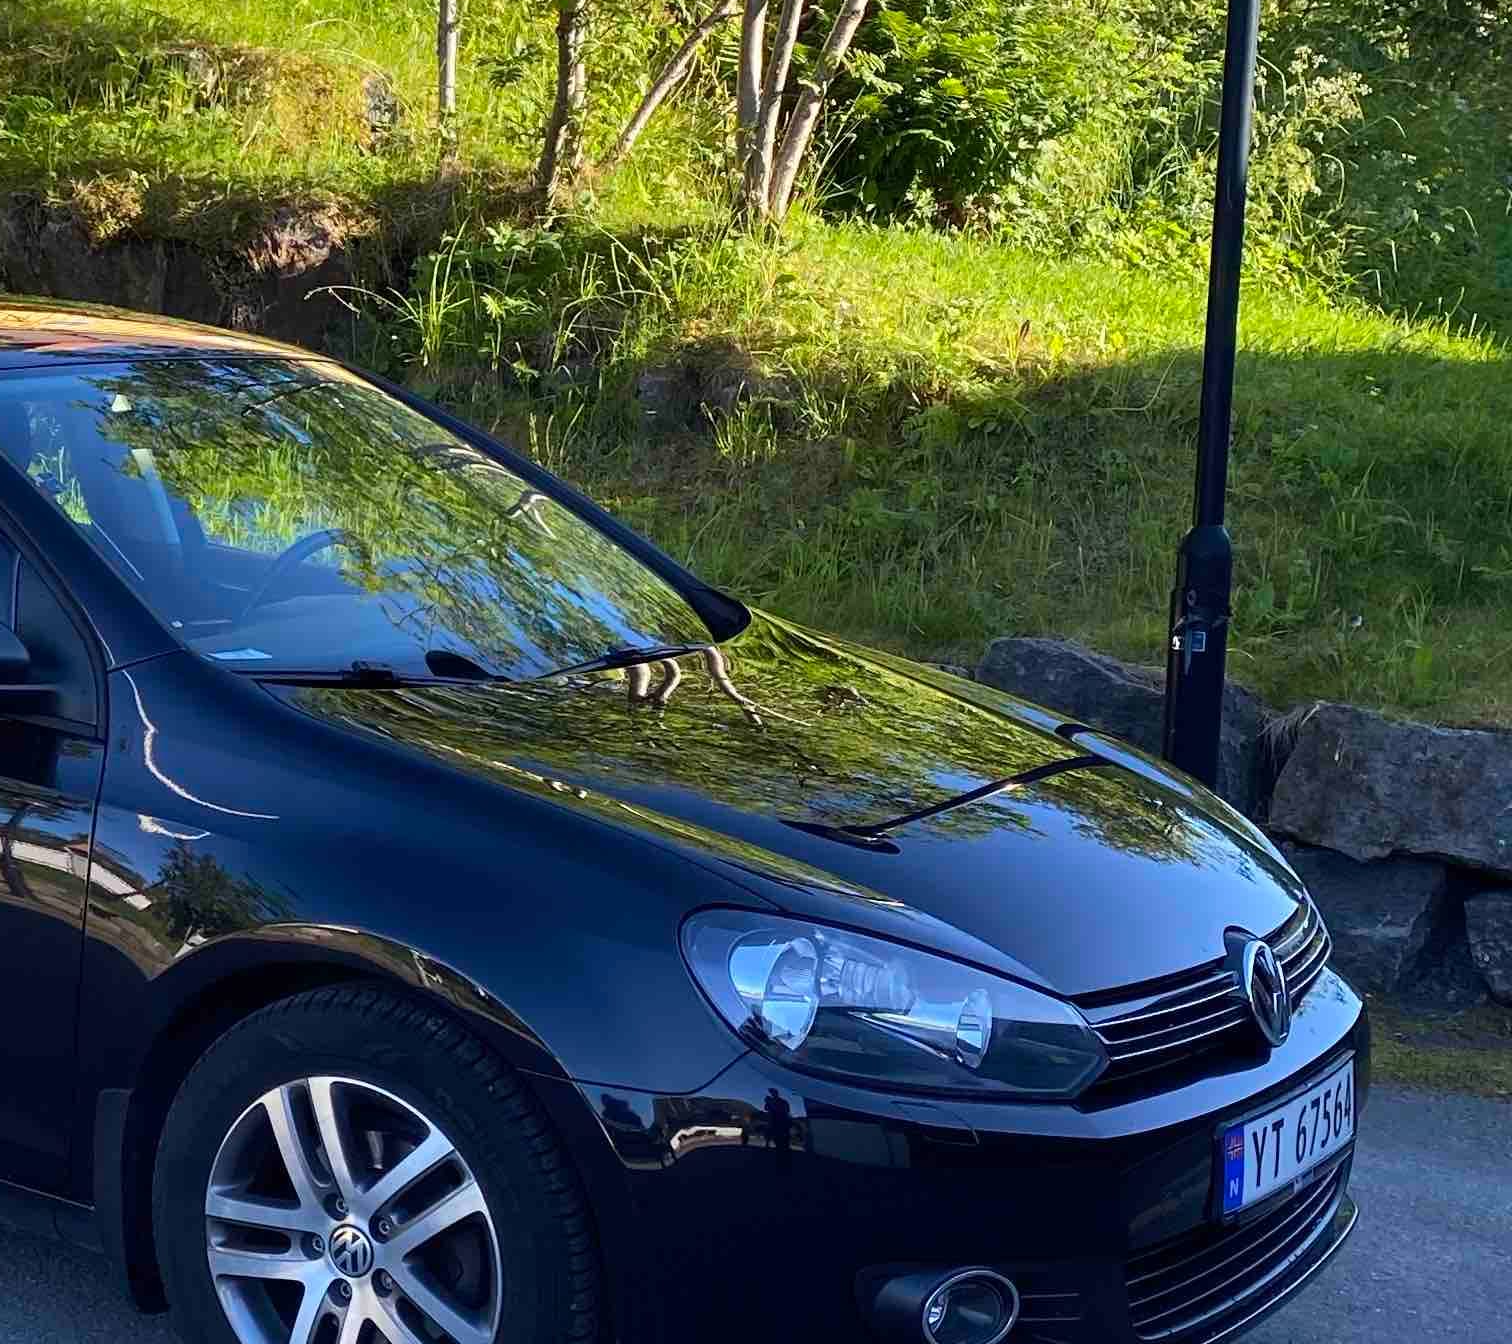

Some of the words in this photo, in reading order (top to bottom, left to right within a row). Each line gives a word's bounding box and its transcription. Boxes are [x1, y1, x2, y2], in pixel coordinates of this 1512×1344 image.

[1252, 1118, 1285, 1188] YT
[1295, 1072, 1352, 1164] 67564
[1229, 1178, 1239, 1199] N
